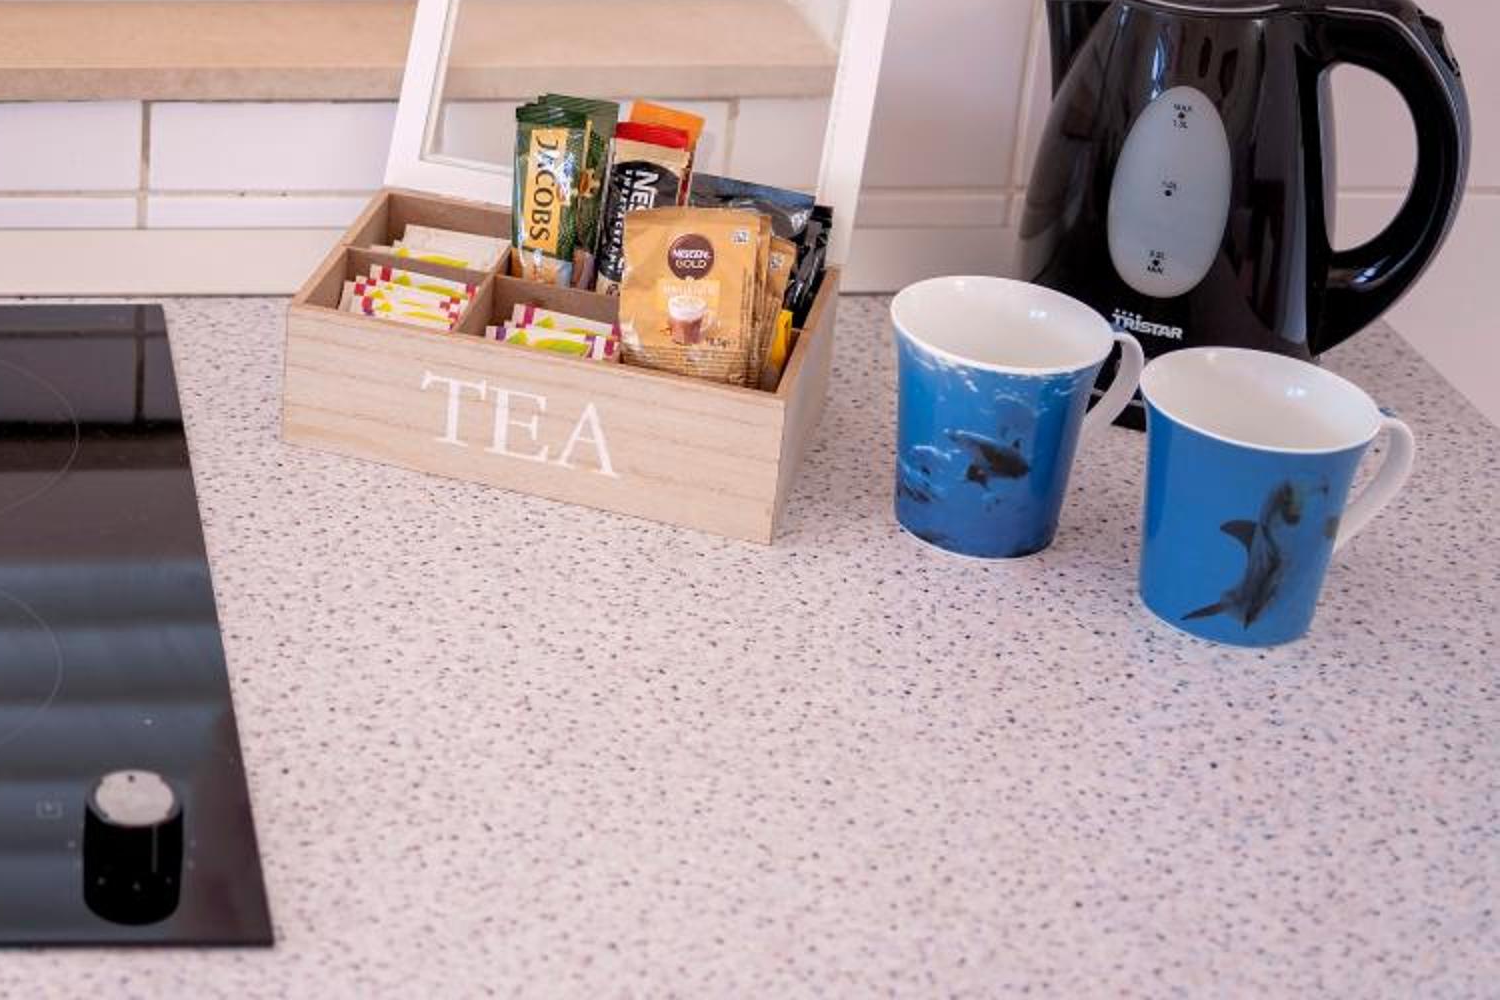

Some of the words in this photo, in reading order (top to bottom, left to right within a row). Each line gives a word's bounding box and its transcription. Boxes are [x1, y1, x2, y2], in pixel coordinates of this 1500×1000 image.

[529, 134, 560, 242] JACOBS
[675, 259, 708, 270] GOLD
[420, 370, 621, 480] TEA
